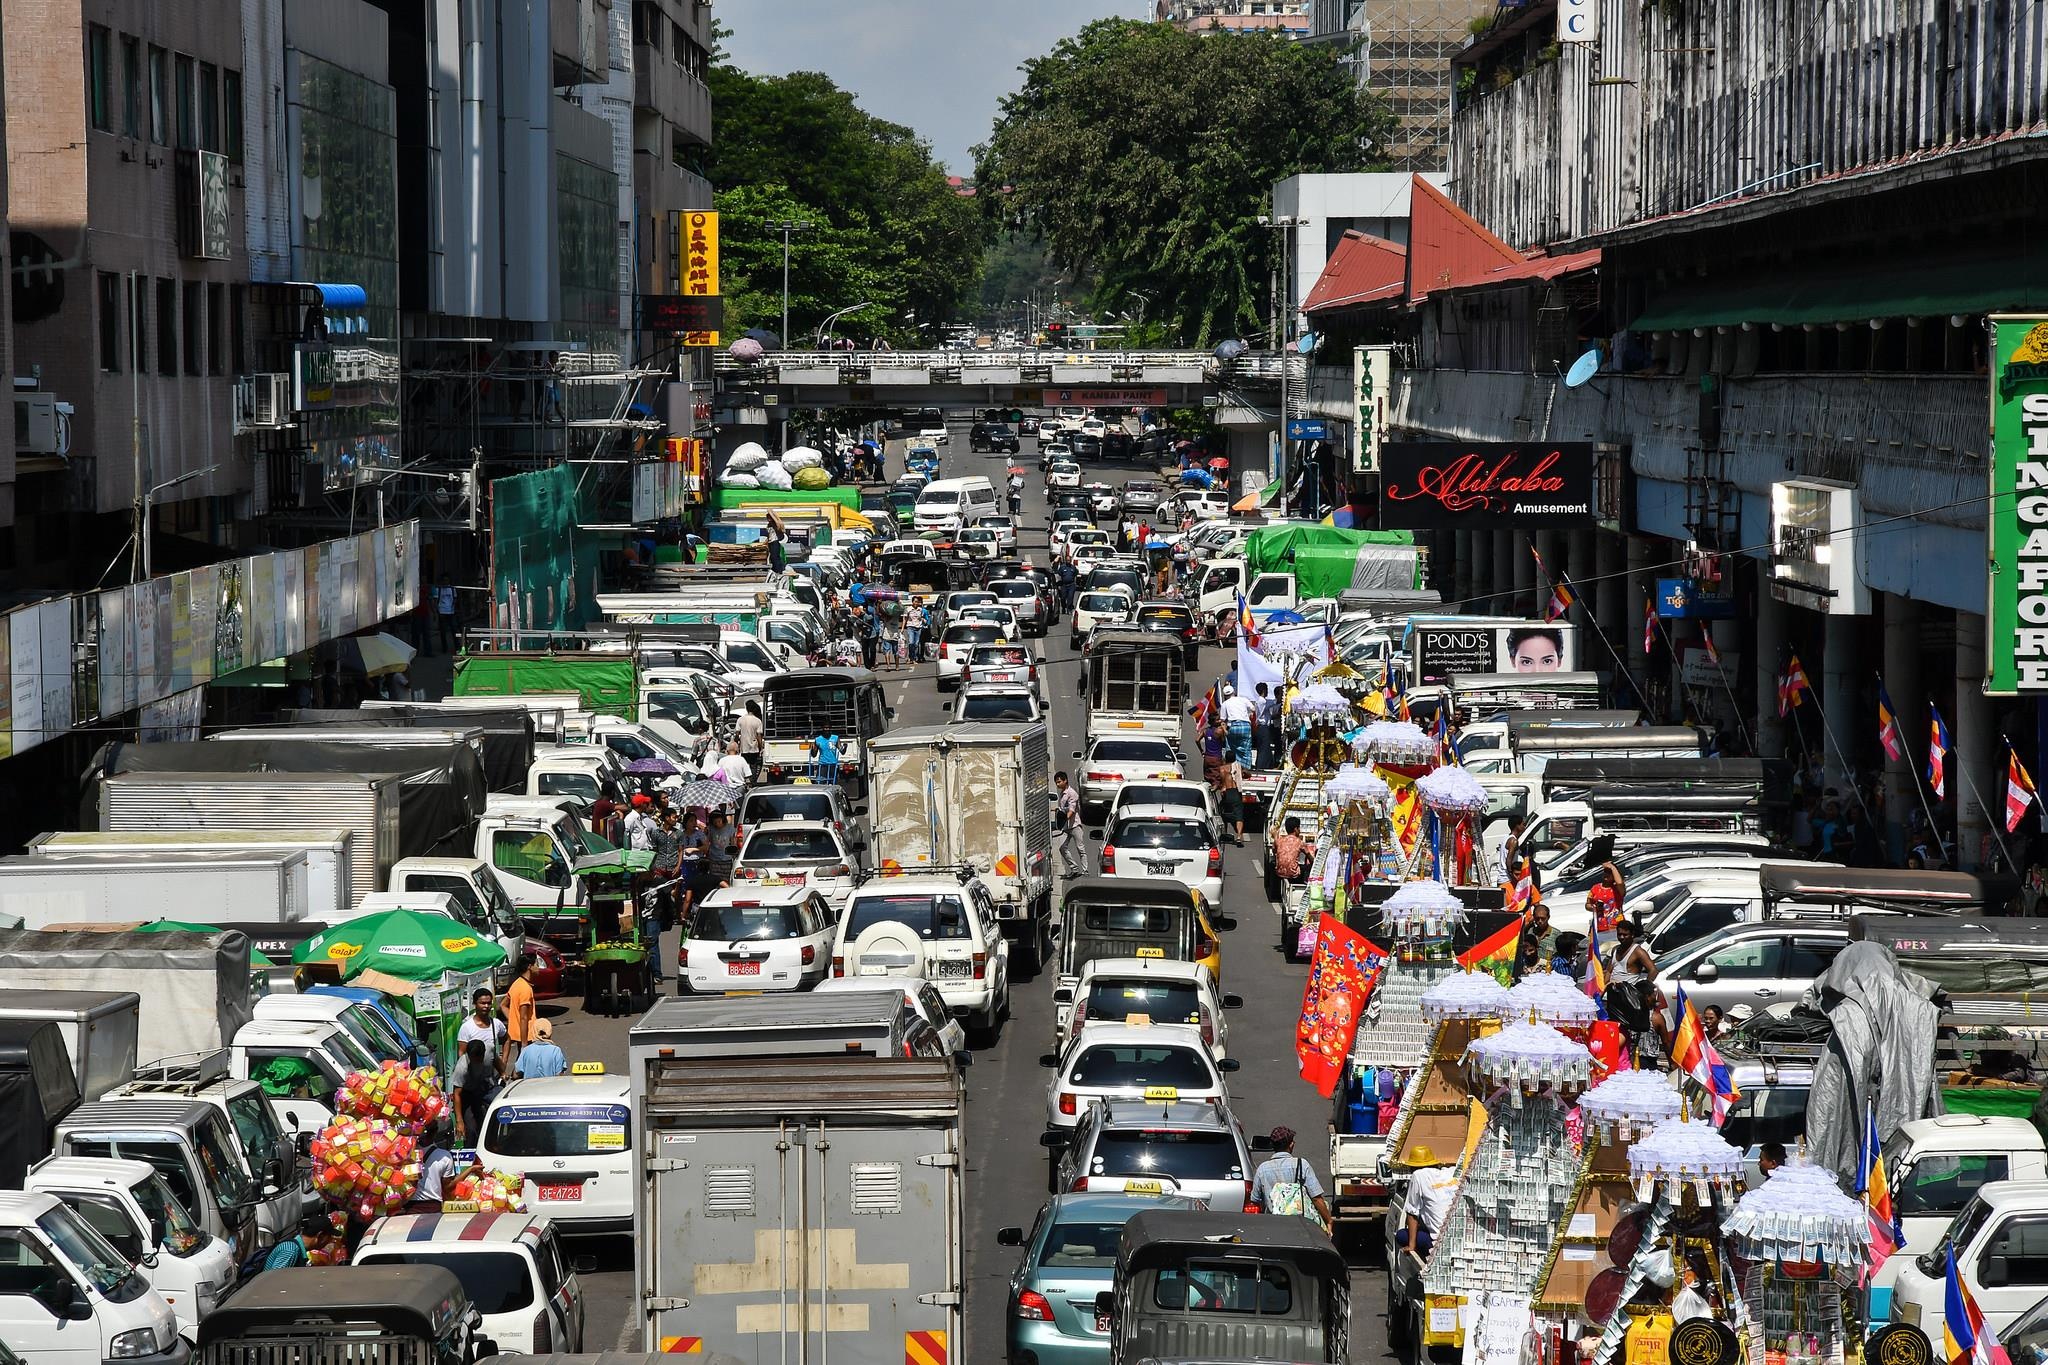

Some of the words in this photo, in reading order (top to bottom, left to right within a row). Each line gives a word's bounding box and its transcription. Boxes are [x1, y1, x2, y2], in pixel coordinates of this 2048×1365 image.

[1081, 390, 1120, 400] KANSAI
[1123, 390, 1152, 400] PAINT
[1514, 503, 1588, 514] Amusement
[1427, 633, 1489, 649] POND'S
[254, 941, 287, 950] APEX
[1895, 941, 1928, 950] APEX
[541, 1188, 580, 1200] 3E-4723
